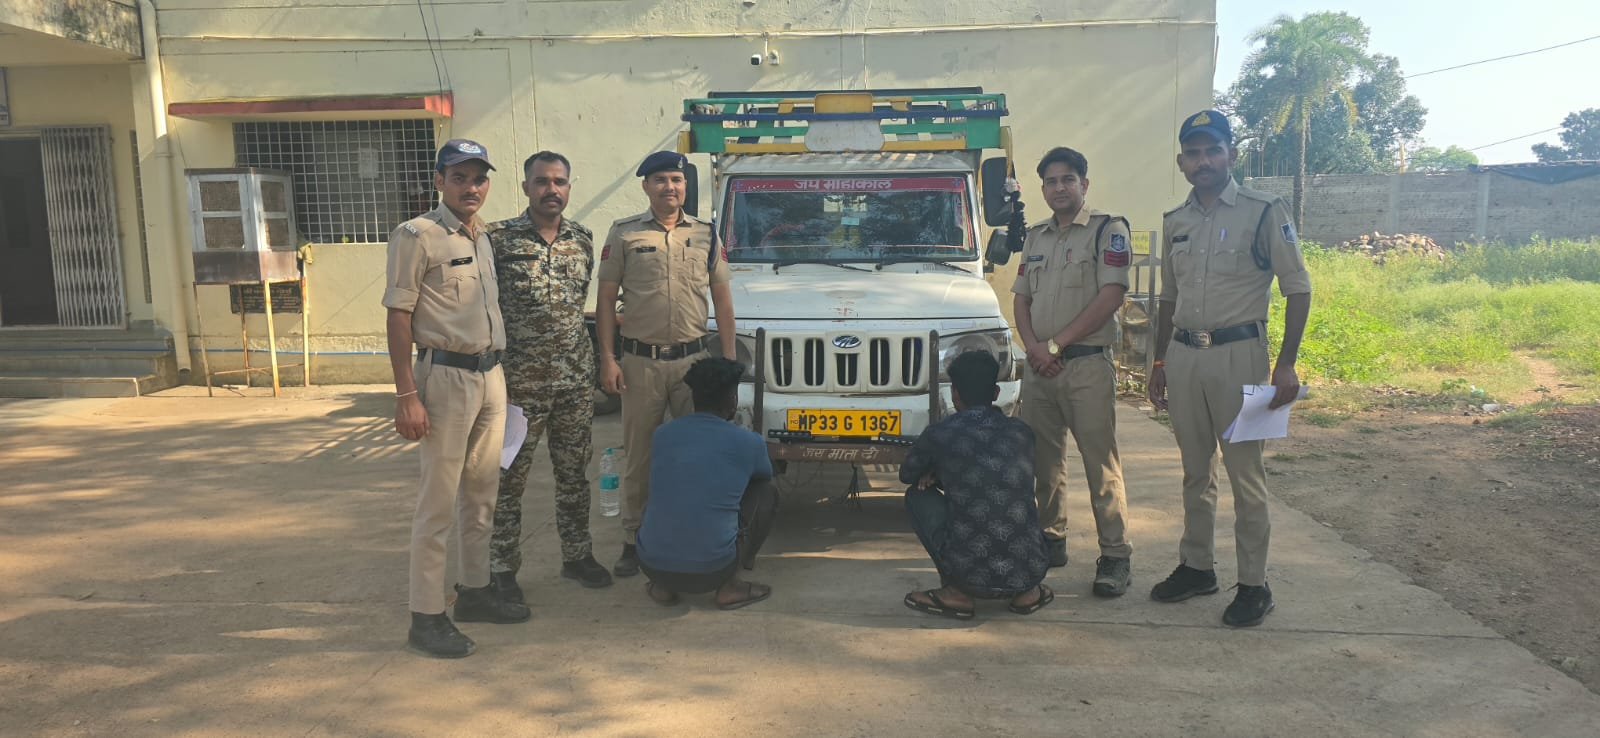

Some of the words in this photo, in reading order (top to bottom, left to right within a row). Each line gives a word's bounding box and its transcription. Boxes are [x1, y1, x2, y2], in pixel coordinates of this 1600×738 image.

[794, 179, 820, 190] जय
[798, 414, 838, 431] MP33
[843, 415, 853, 431] G
[860, 415, 898, 432] 1367
